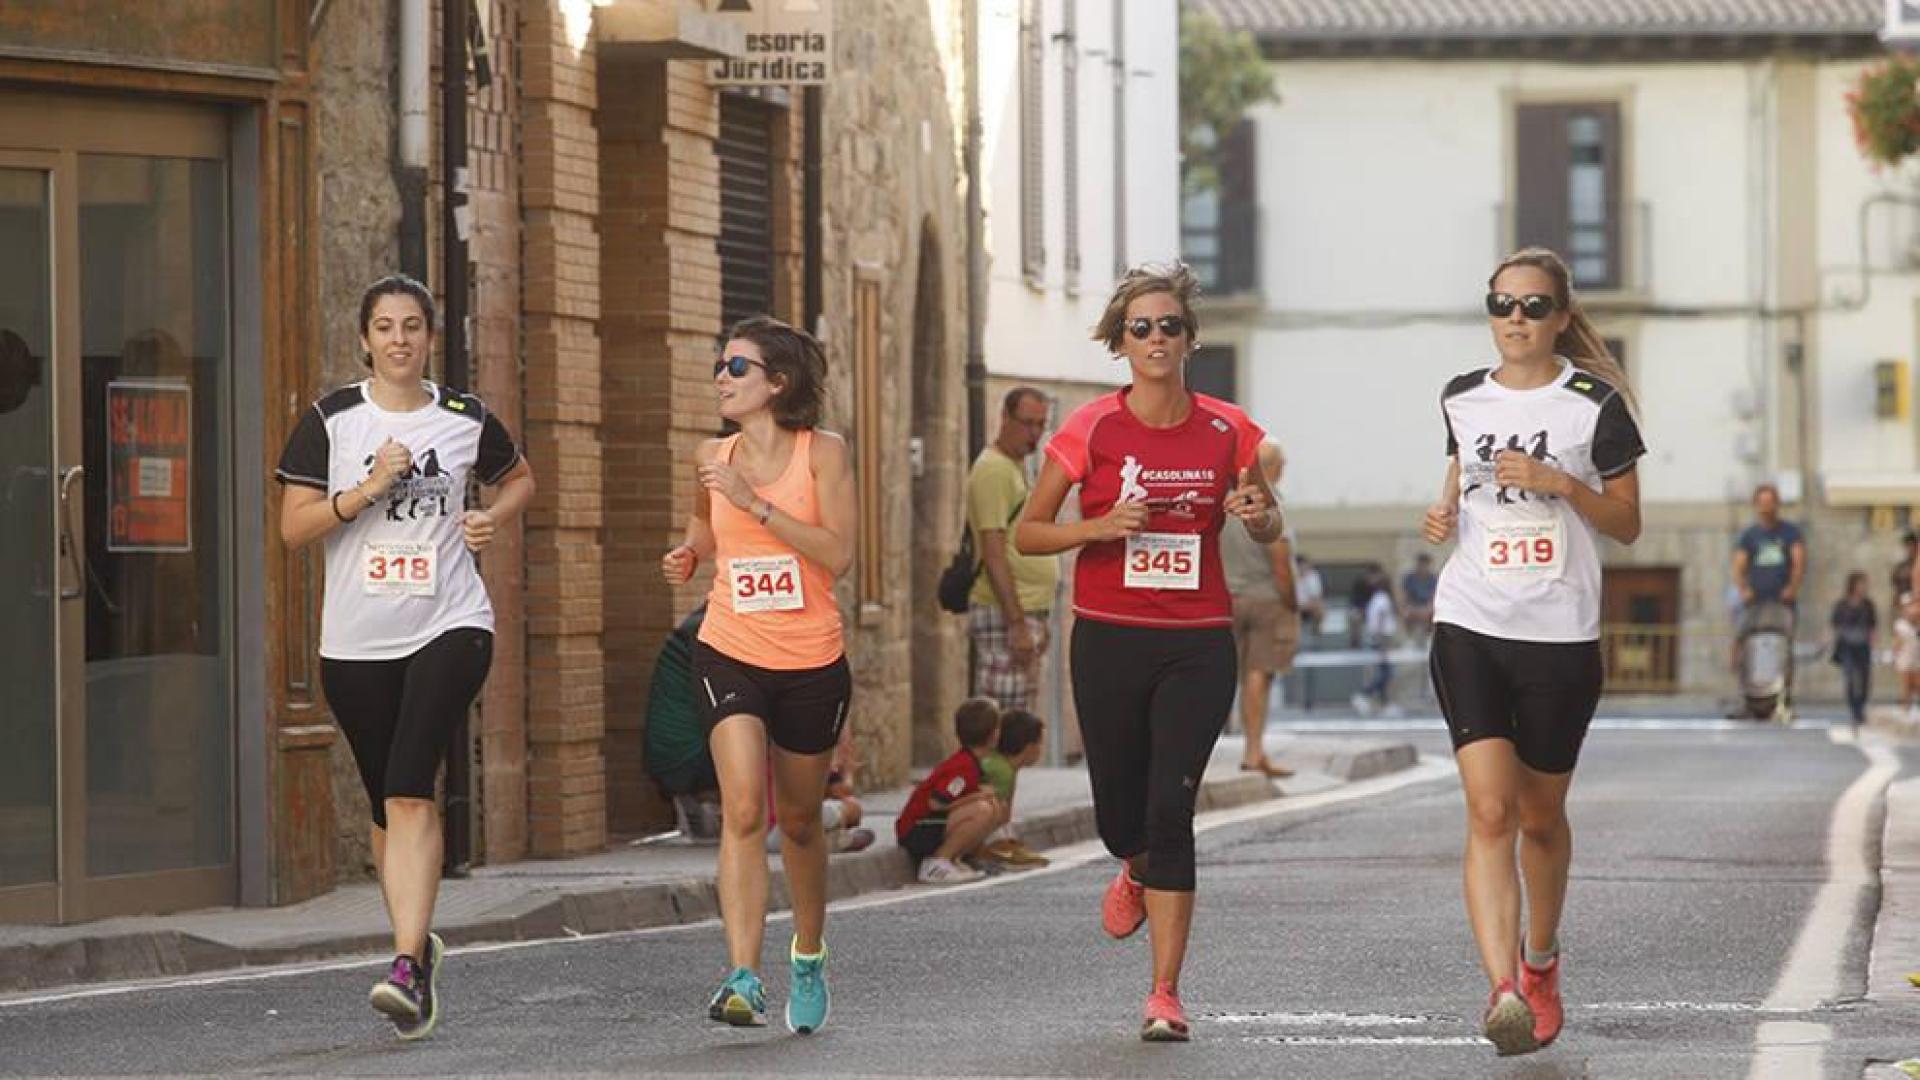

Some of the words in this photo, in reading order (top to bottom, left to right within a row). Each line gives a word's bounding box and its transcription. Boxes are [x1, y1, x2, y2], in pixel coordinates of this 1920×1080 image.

[745, 29, 824, 52] esoría
[1132, 550, 1192, 574] 345
[1490, 539, 1553, 564] 319
[368, 556, 430, 580] 318
[737, 571, 795, 597] 344
